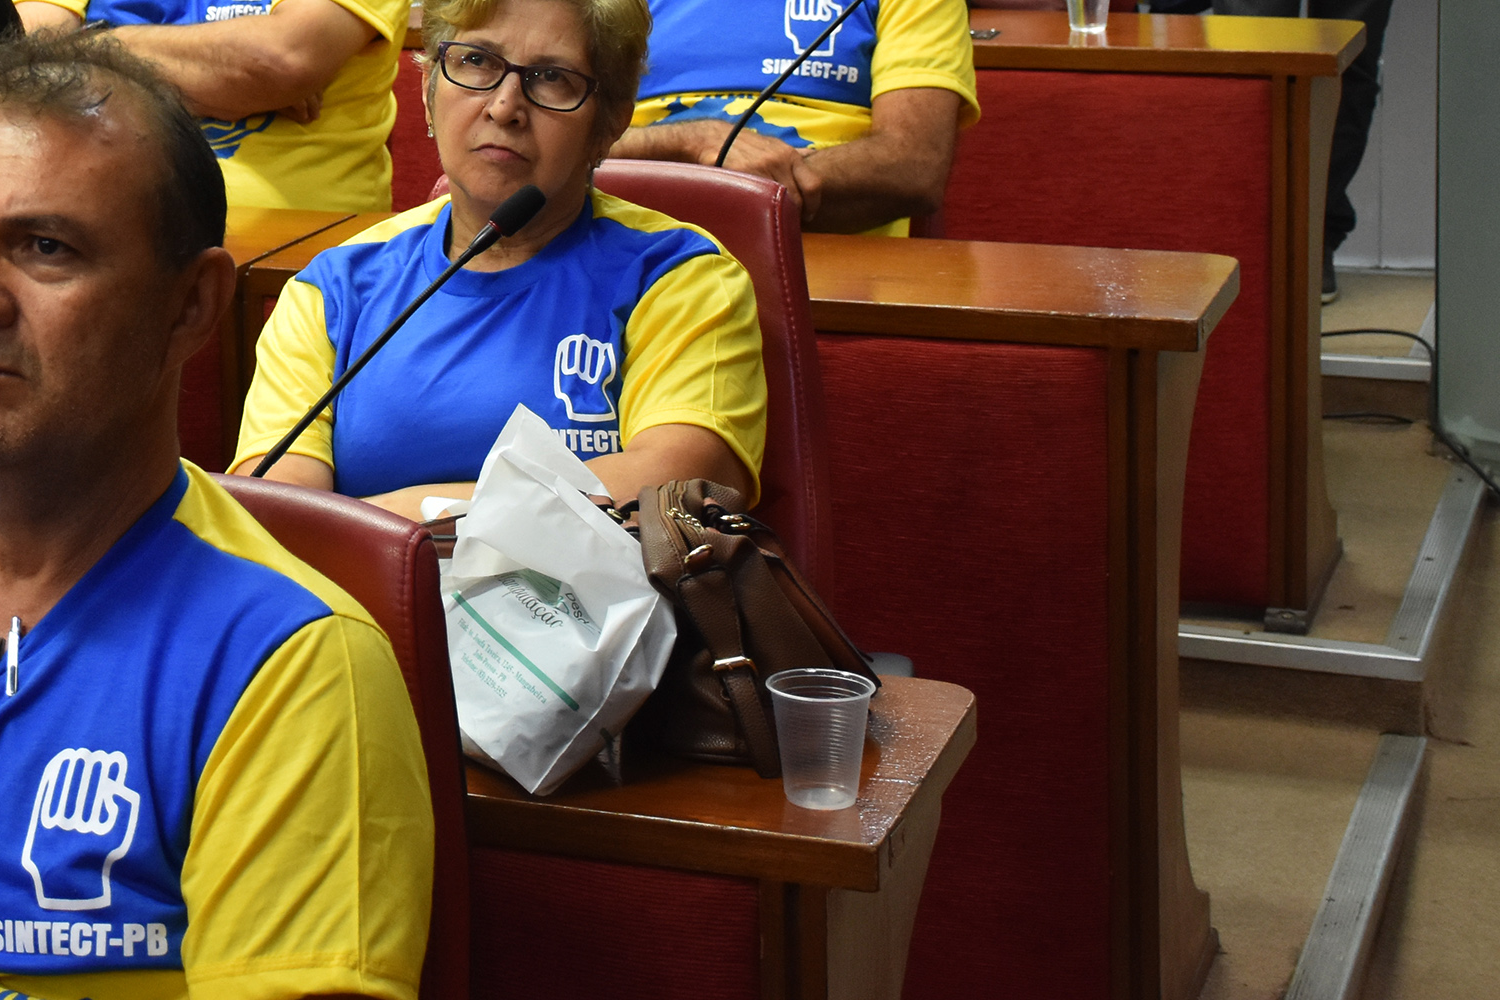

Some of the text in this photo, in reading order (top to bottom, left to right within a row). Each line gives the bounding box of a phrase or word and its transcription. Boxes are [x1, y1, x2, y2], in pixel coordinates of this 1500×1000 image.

[205, 4, 273, 21] SINTECT-
[762, 58, 859, 84] SINTECT-PB
[512, 670, 549, 705] Mangabeira
